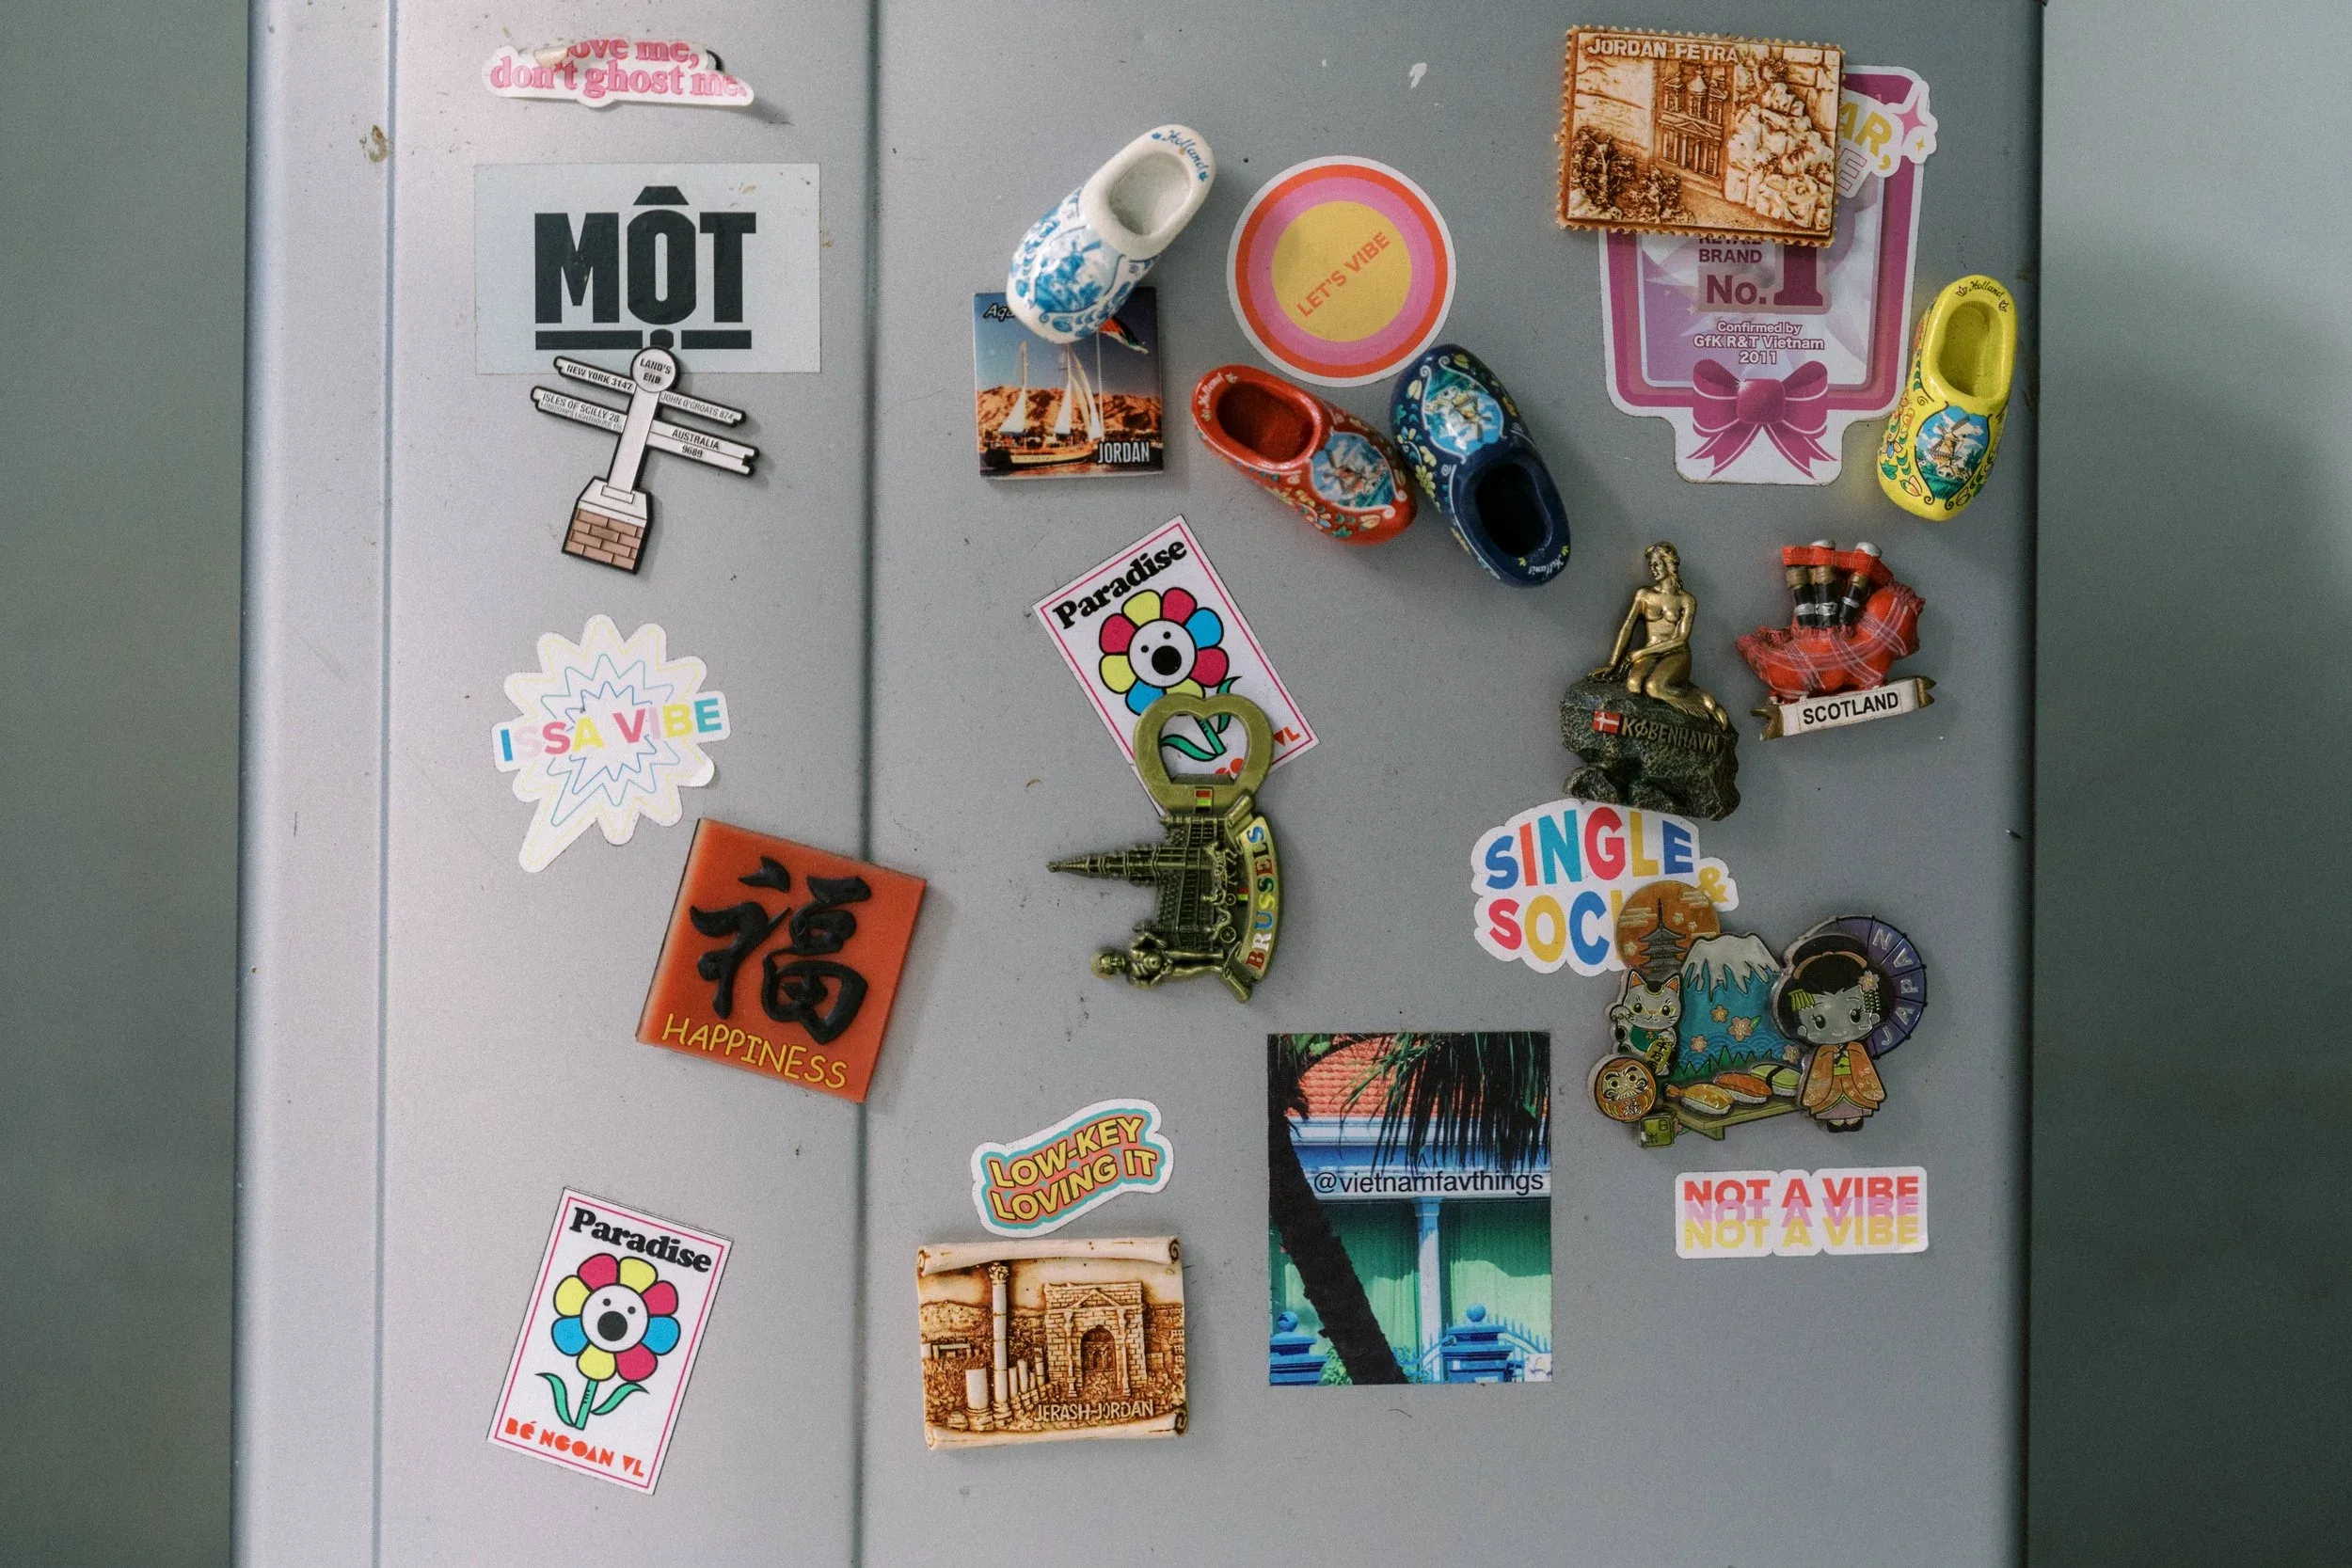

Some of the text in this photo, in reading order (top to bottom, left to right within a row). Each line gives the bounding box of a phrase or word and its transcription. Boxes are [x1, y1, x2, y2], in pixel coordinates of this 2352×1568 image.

[566, 39, 628, 58] ove
[489, 55, 578, 90] don't
[582, 60, 685, 99] ghost
[1699, 248, 1763, 264] BRAND
[1296, 230, 1391, 318] LET'S VIBE
[1968, 279, 2005, 300] Holland
[1693, 334, 1825, 350] GfK R&T Vietnam
[1717, 321, 1804, 336] Confirmed by
[640, 356, 673, 375] LAND'S
[1739, 350, 1778, 365] 2011
[566, 364, 633, 391] NEW YORK 3147
[643, 372, 662, 386] END
[542, 392, 620, 423] ISLES OF SCILLY 28
[660, 393, 682, 406] JOHN
[682, 399, 719, 418] O'GROATS
[671, 428, 720, 451] AUSTRALIA
[682, 444, 704, 458] 9689
[1097, 439, 1152, 466] JORDAN
[1052, 540, 1188, 630] Paradise
[612, 697, 723, 745] VIBE
[1803, 691, 1899, 725] SCOTLAND
[1485, 806, 1729, 904] SINGLE &
[1245, 824, 1275, 971] BRUSSELS
[690, 855, 872, 1045] 福
[1872, 927, 1919, 1046] JAPAN
[661, 1013, 849, 1089] HAPPINESS
[990, 1117, 1144, 1189] LOW-KEY
[991, 1148, 1157, 1221] LOVING IT
[1313, 1169, 1544, 1196] @vietnamfavthings
[1684, 1176, 1919, 1210] NOT A VIBE
[568, 1206, 712, 1274] Paradise
[1684, 1215, 1919, 1250] NOT A VIBE
[504, 1417, 645, 1478] BÉ NGOAN VL
